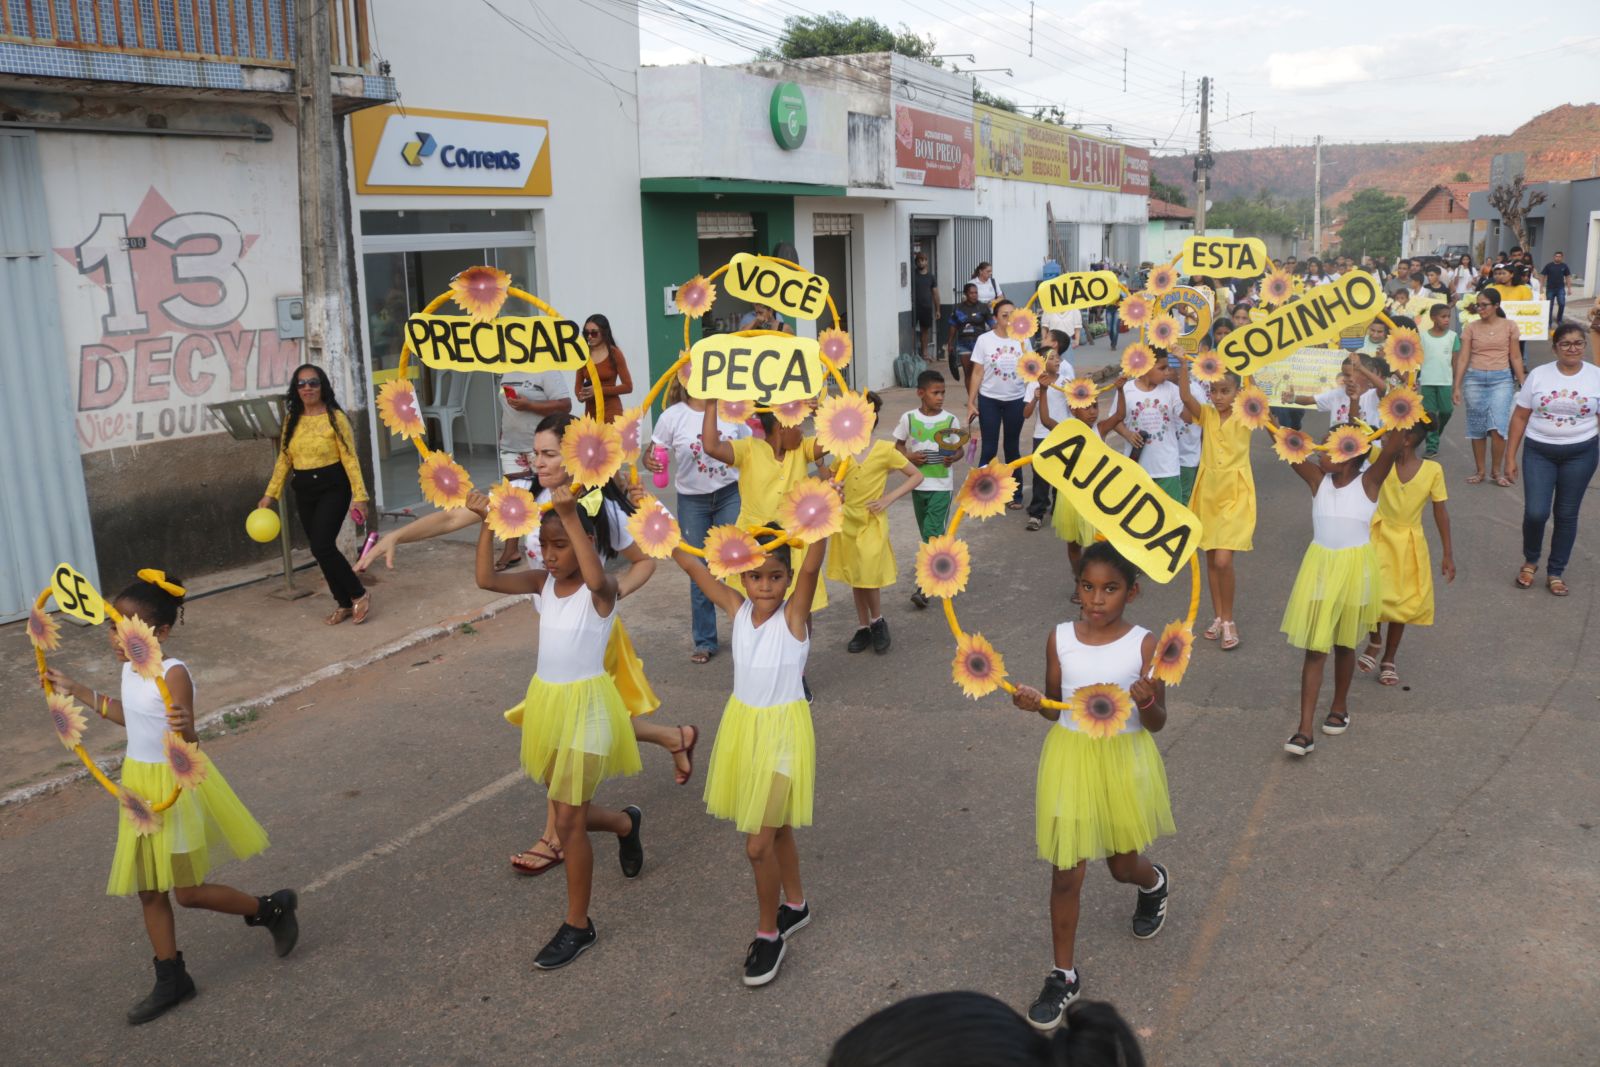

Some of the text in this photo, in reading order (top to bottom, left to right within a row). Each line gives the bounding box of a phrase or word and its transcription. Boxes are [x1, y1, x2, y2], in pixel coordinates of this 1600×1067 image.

[440, 145, 521, 170] Correios
[914, 138, 962, 168] BOM PREÇO
[1068, 134, 1121, 188] DERIM
[74, 211, 250, 337] 13
[1192, 242, 1258, 270] ESTA
[736, 262, 823, 314] VOCÊ
[1050, 276, 1109, 307] NÃO
[1161, 291, 1205, 310] SOU LUZ
[407, 319, 586, 364] PRECISAR
[1224, 276, 1376, 372] SOZINHO
[701, 348, 812, 402] PEÇA
[75, 411, 133, 449] Vice:
[1040, 434, 1192, 574] AJUDA
[56, 567, 96, 618] SE
